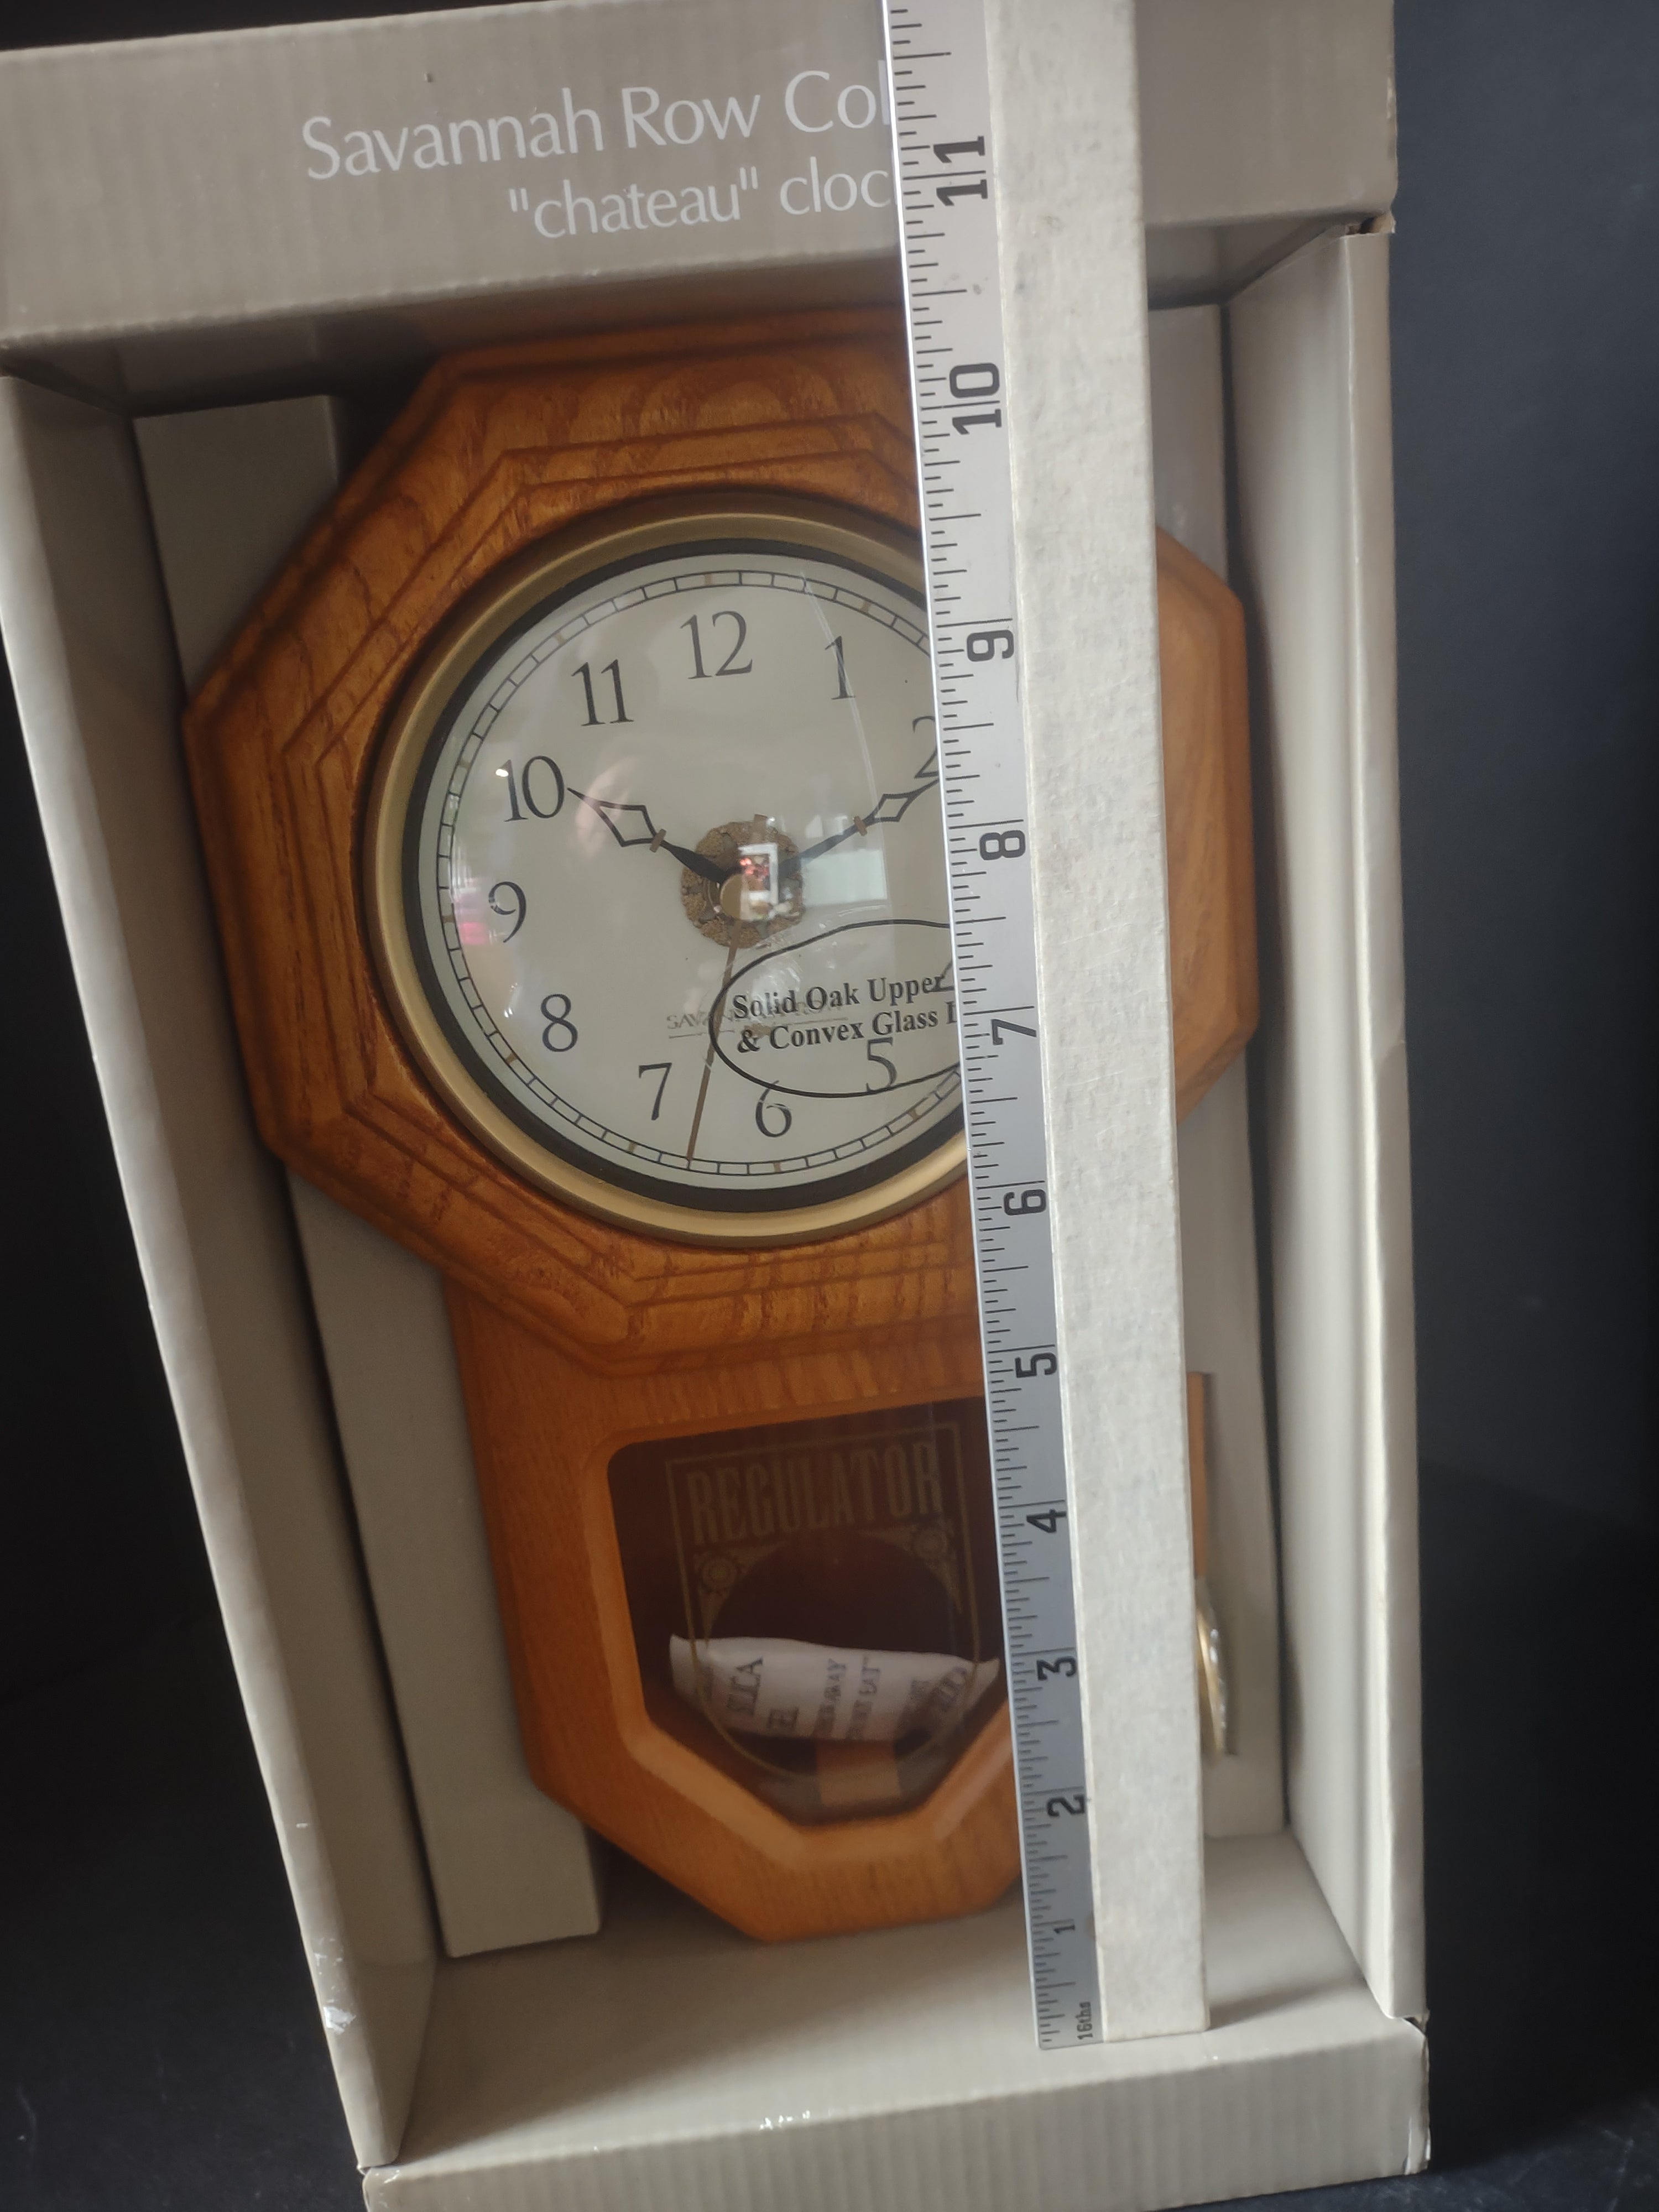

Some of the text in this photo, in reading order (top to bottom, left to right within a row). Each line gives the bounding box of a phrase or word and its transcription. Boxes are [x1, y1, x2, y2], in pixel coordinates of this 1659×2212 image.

[302, 87, 604, 180] Savannah
[622, 85, 761, 148] Row
[509, 156, 895, 239] "chateau" cloc
[932, 136, 988, 206] 11
[948, 362, 1002, 435] 10
[680, 610, 753, 679] 12
[825, 635, 855, 700] 1
[571, 659, 634, 727] 11
[502, 755, 565, 823] 10
[979, 830, 1026, 860] 8
[488, 881, 527, 943] 9
[540, 994, 578, 1052] 8
[733, 977, 942, 1019] Solid Oak Upper
[737, 1029, 760, 1053] &
[769, 1021, 864, 1050] Convex
[872, 1010, 939, 1036] Glass
[990, 1018, 1037, 1046] 7
[638, 1062, 672, 1121] 7
[865, 1036, 898, 1093] 5
[755, 1080, 792, 1138] 6
[1014, 1351, 1058, 1378] 5
[686, 1441, 944, 1547] REGULATOR
[1026, 1507, 1067, 1533] 4
[1036, 1656, 1077, 1682] 3
[1046, 1794, 1086, 1818] 2
[1053, 1924, 1076, 1934] 1
[1075, 2001, 1094, 2040] 16ths
